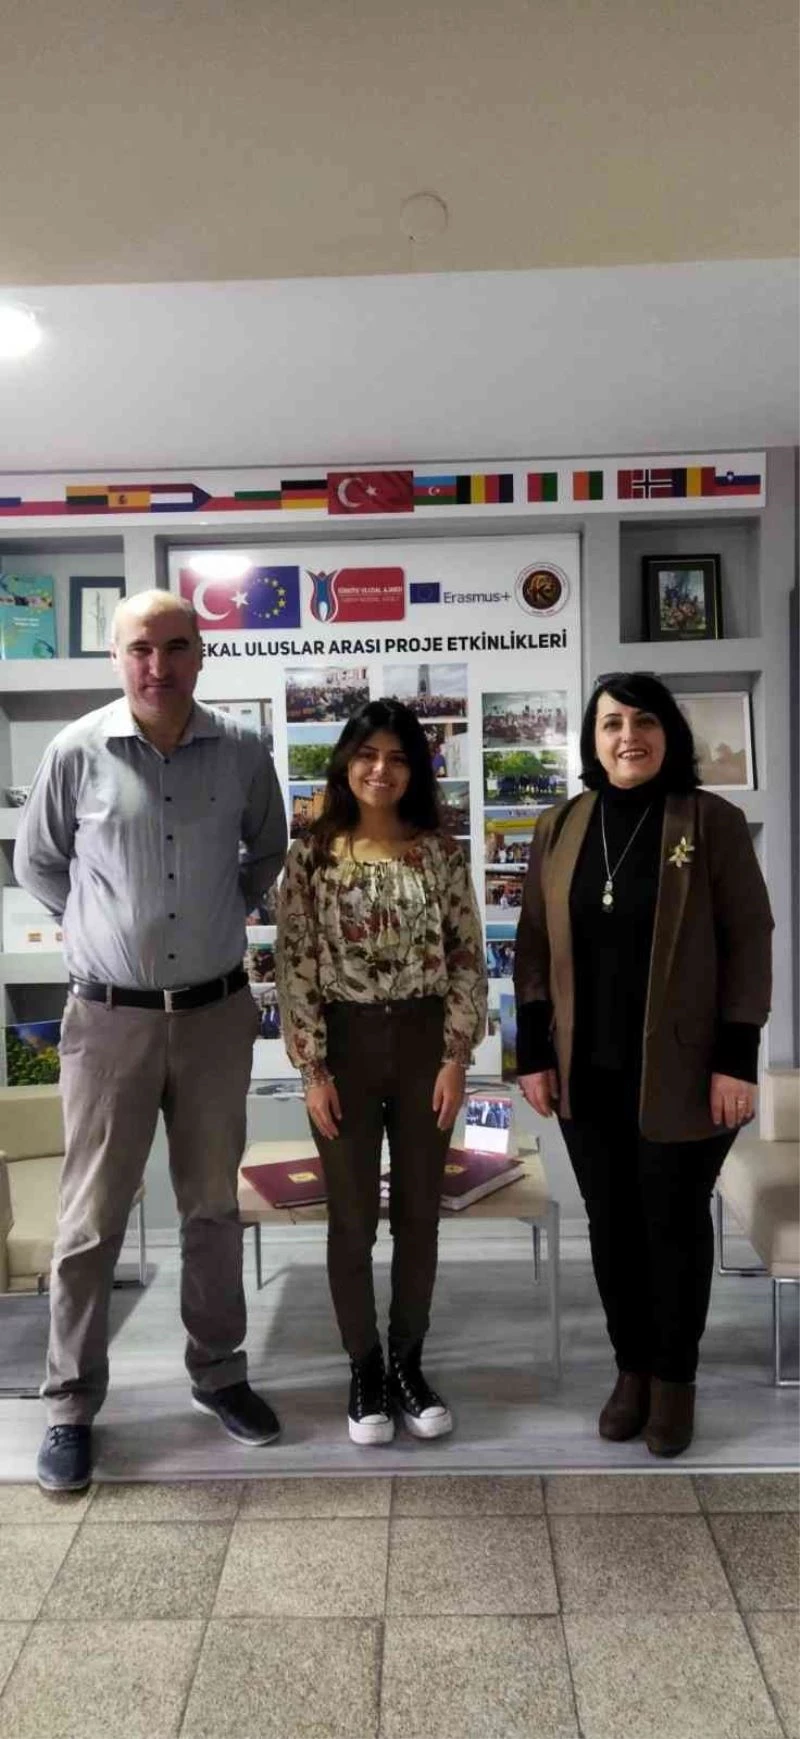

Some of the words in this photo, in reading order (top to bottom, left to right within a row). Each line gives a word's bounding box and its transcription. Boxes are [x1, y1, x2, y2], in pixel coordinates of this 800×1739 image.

[443, 591, 513, 604] Erasmus+
[245, 640, 325, 656] ULUSLAR
[327, 638, 381, 655] ARASI
[384, 636, 443, 653] PROJE
[447, 628, 567, 651] ETKİNLİKLERİ
